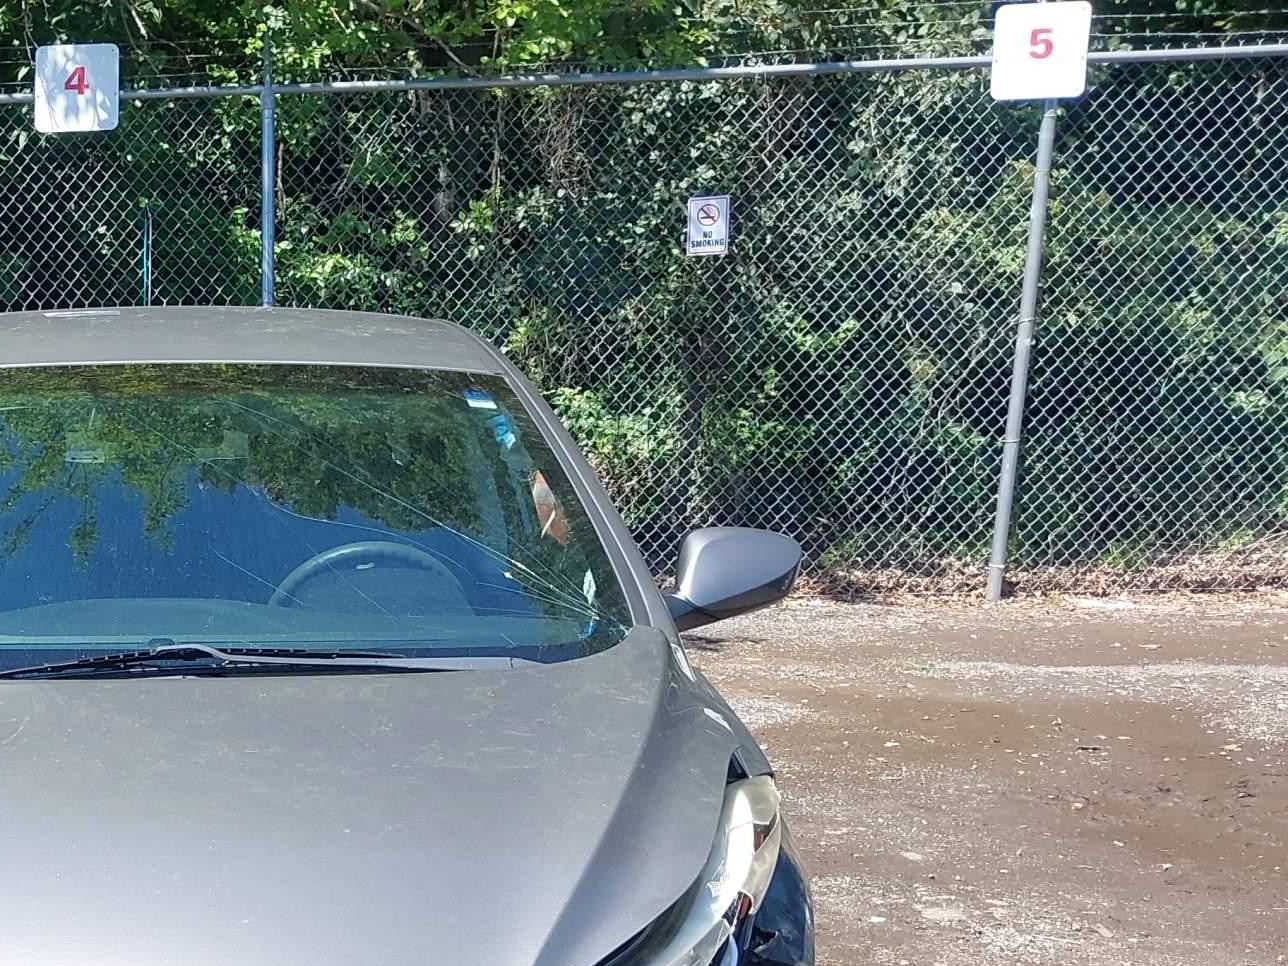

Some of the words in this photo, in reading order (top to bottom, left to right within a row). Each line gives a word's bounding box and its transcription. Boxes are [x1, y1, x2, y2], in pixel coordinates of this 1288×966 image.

[1029, 28, 1054, 59] 5
[64, 66, 90, 95] 4
[691, 238, 725, 248] SMOKING
[703, 231, 713, 239] NO
